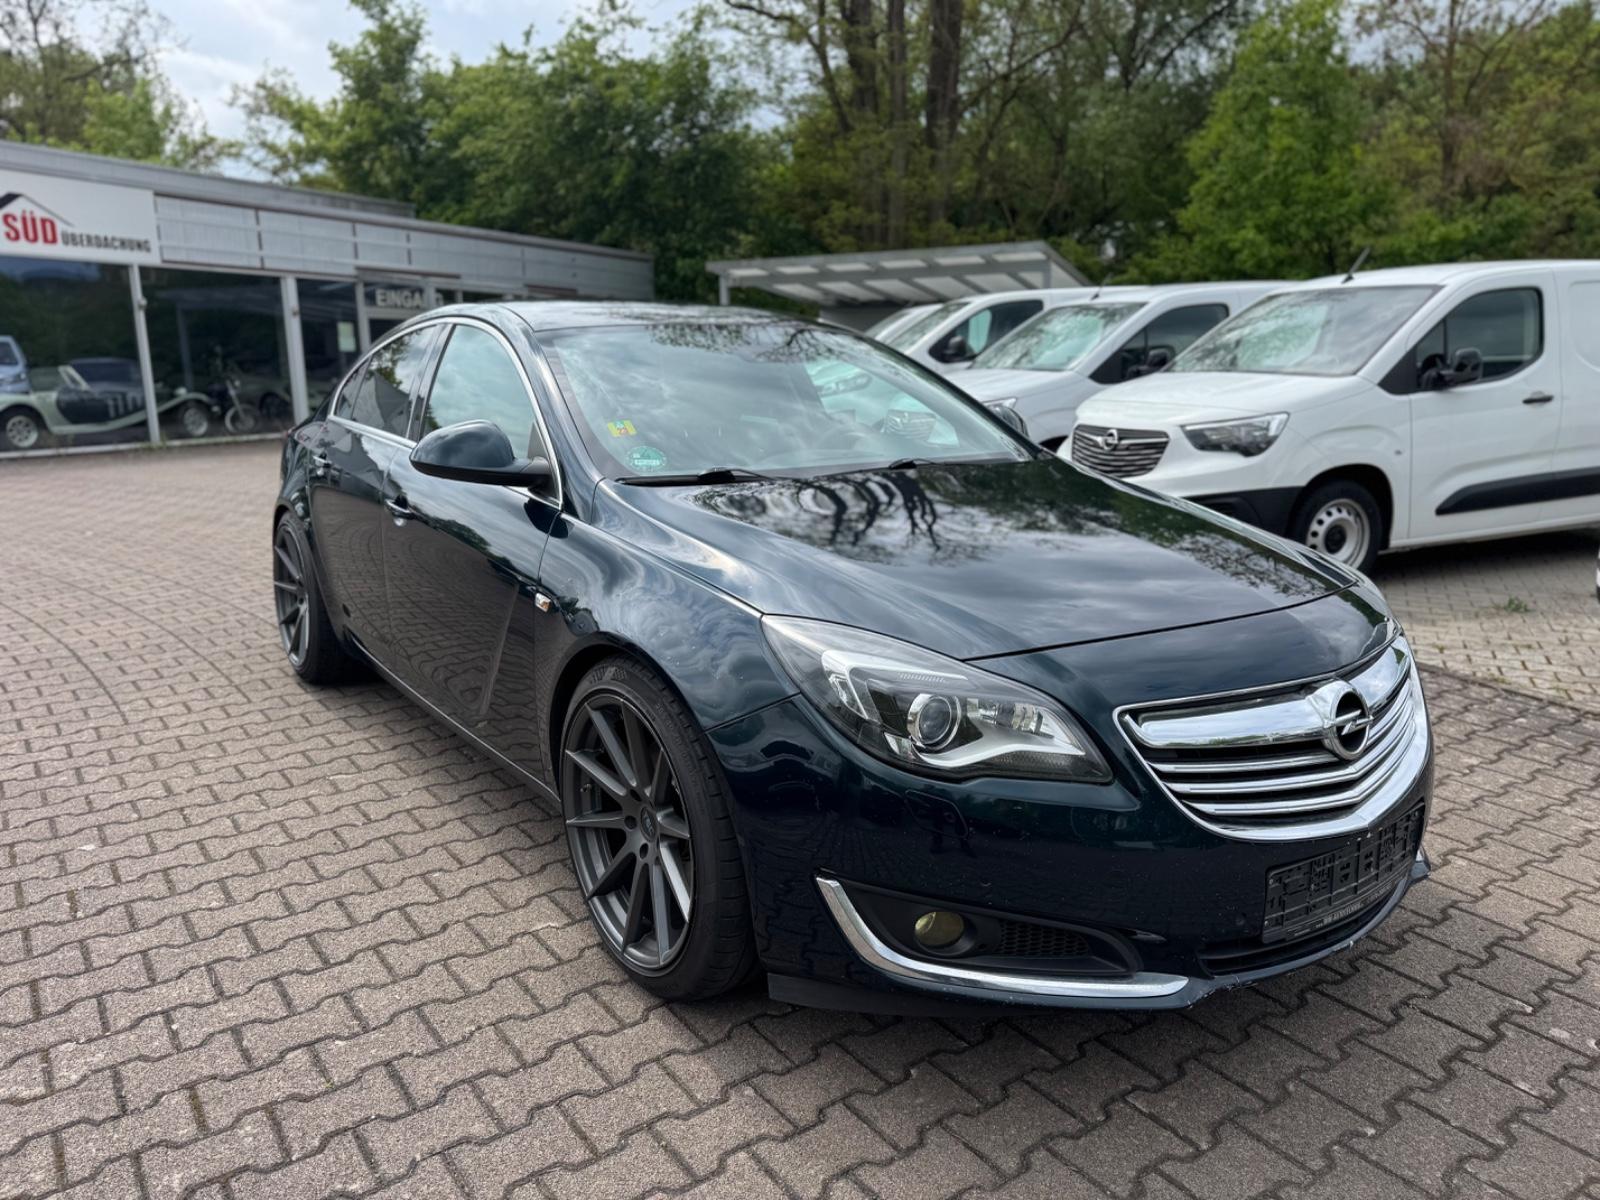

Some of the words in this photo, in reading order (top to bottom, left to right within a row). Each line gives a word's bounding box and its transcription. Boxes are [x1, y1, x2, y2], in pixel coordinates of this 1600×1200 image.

[2, 209, 58, 245] SÜD
[61, 229, 152, 253] ÜBERDACHUNG
[375, 288, 445, 308] EINGAG
